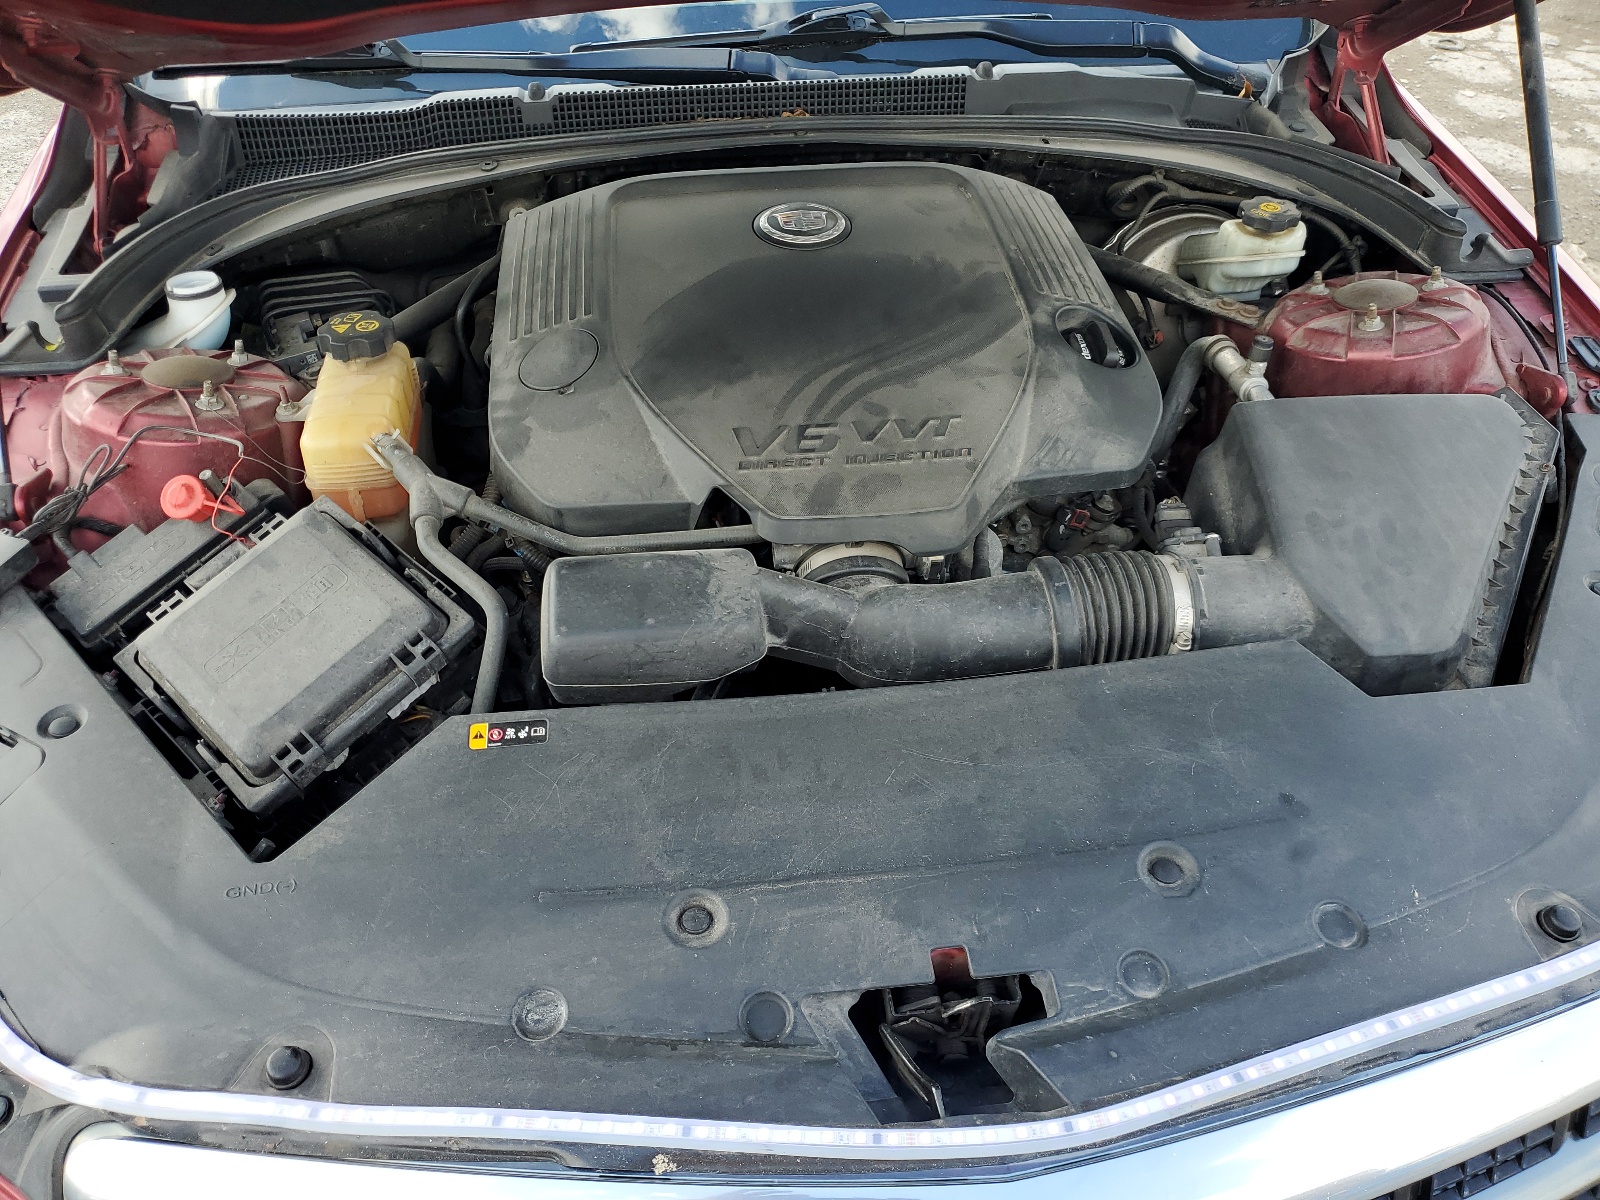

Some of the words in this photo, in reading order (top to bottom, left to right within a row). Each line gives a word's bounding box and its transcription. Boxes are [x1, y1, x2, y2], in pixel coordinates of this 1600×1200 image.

[732, 423, 839, 456] V6
[851, 414, 962, 444] VVT
[738, 456, 830, 471] DIRECT
[845, 447, 972, 465] INJECTION
[225, 879, 298, 899] GND(-)
